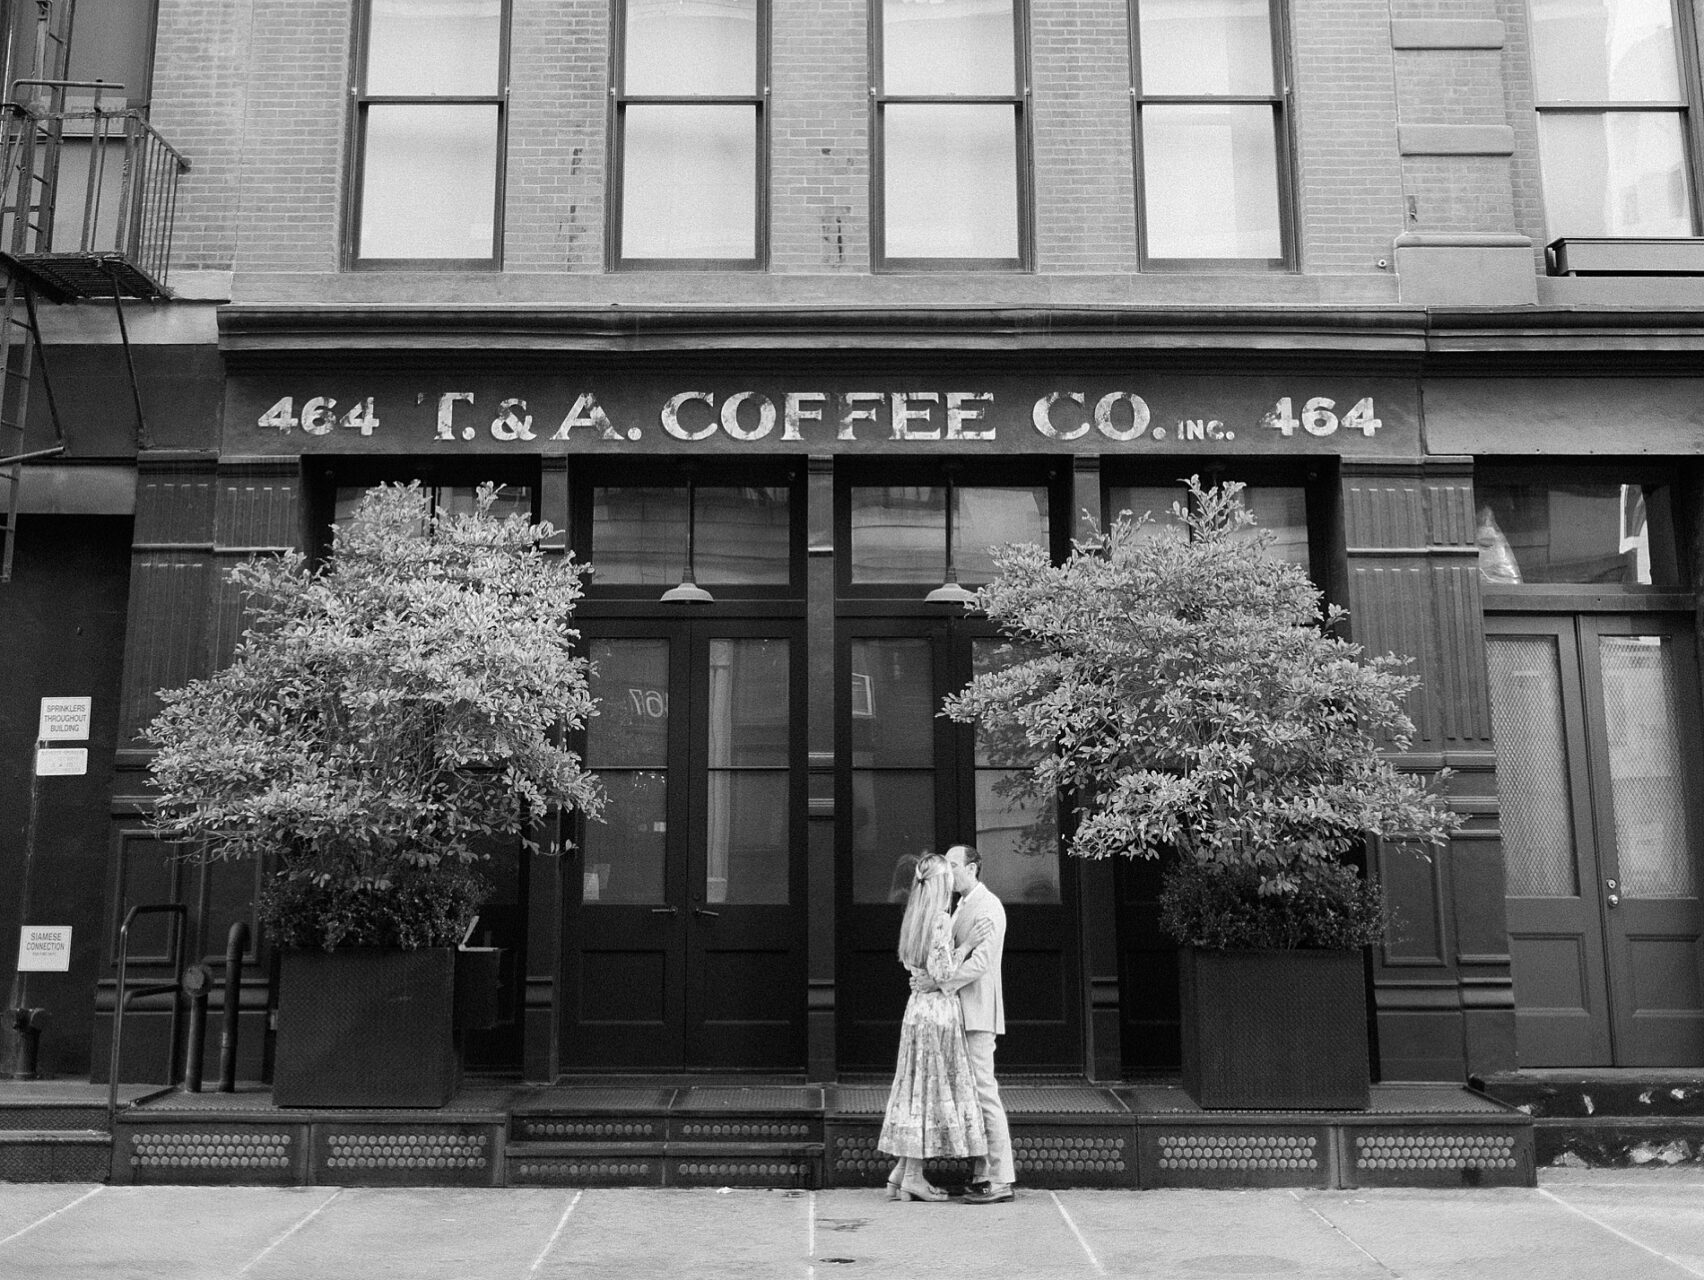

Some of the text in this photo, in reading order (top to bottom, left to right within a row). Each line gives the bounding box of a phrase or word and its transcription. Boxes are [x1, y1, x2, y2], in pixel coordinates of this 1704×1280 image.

[257, 396, 380, 437] 464
[417, 391, 1235, 441] T. & A. COFFEE CO. INC.
[1258, 396, 1383, 437] 464
[47, 704, 86, 713] SPRINKLERS
[44, 714, 87, 723] THROUGHOUT
[50, 724, 79, 733] BUILDING
[30, 932, 62, 941] SIAMESE
[26, 942, 65, 951] CONNECTION
